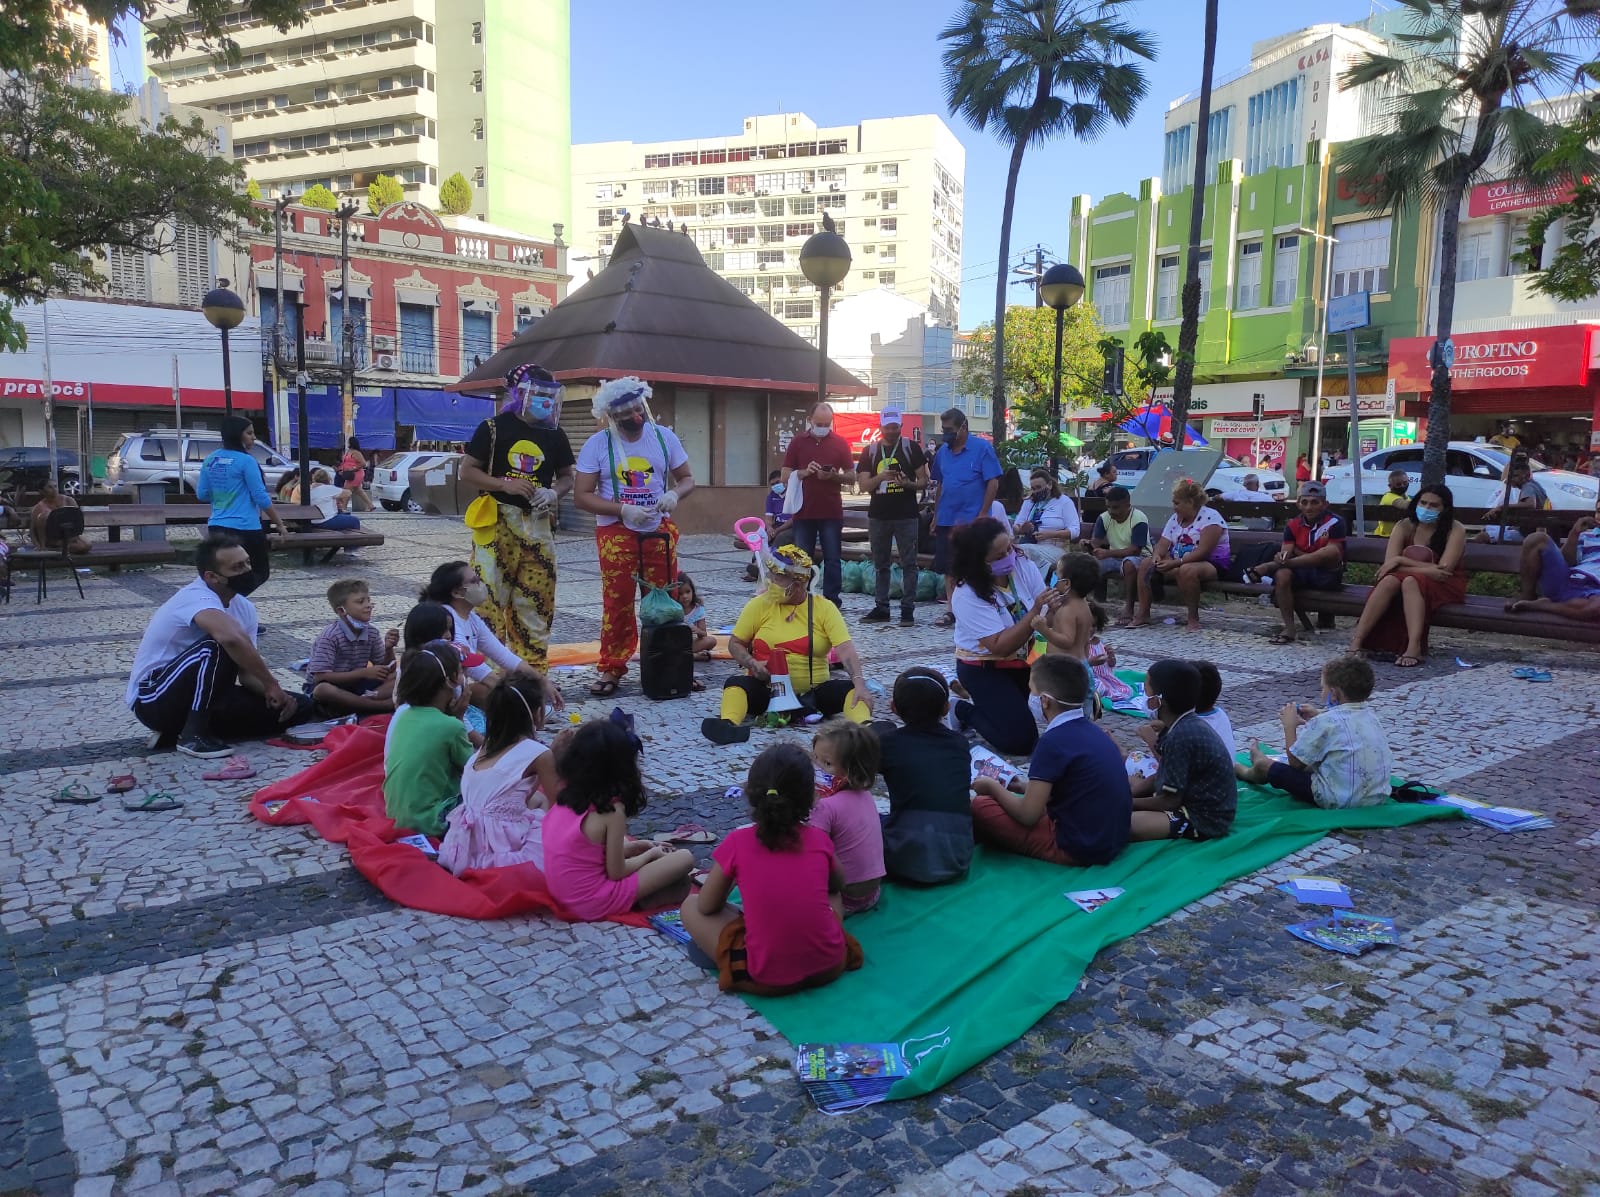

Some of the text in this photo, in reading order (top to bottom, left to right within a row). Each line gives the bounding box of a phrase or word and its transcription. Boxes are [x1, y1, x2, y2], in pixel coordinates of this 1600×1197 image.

[1297, 47, 1330, 71] CASA
[1426, 341, 1538, 361] UROFINO
[3, 382, 37, 396] pra
[620, 493, 654, 501] CRIANÇA
